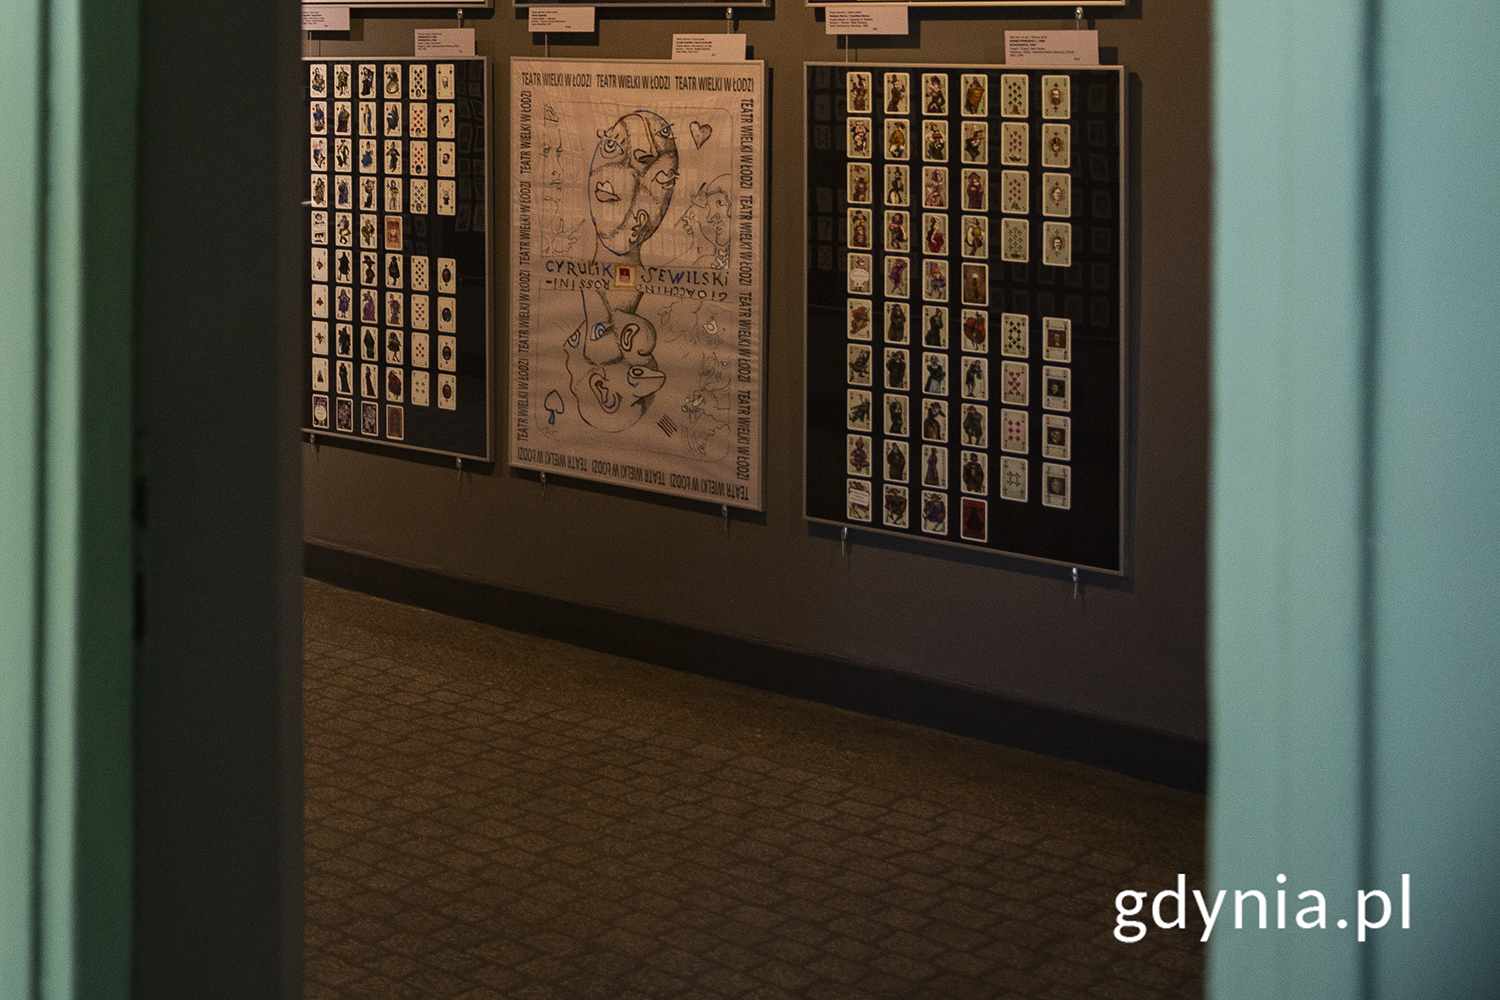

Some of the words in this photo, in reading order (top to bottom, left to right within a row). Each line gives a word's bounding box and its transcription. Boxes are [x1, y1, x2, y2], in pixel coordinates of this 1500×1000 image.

[522, 72, 541, 86] TEATR
[542, 73, 563, 86] WIELKI
[565, 74, 572, 86] W
[572, 73, 592, 88] ŁODZI
[597, 74, 617, 88] TEATR
[618, 75, 640, 89] WIELKI
[642, 75, 650, 89] W
[650, 75, 670, 90] ŁODZI
[675, 76, 696, 90] TEATR
[698, 77, 722, 91] WIELKI
[724, 78, 731, 91] W
[732, 78, 754, 92] ŁODZI
[520, 91, 532, 112] ŁODZI
[741, 99, 753, 123] TEATR
[520, 114, 531, 122] W
[520, 123, 531, 149] WIELKI
[740, 125, 753, 152] WIELKI
[520, 151, 531, 174] TEATR
[740, 155, 752, 163] W
[740, 164, 753, 189] ŁODZI
[519, 181, 531, 203] ŁODZI
[520, 205, 530, 213] W
[739, 195, 753, 220] TEATR
[520, 213, 530, 240] WIELKI
[740, 222, 752, 249] WIELKI
[520, 242, 531, 265] TEATR
[740, 251, 752, 260] W
[518, 270, 530, 292] ŁODZI
[739, 262, 752, 286] ŁODZI
[518, 302, 530, 328] WIELKI
[738, 292, 752, 317] TEATR
[518, 330, 530, 353] TEATR
[738, 319, 752, 346] WIELKI
[738, 349, 751, 357] W
[518, 358, 529, 381] ŁODZI
[738, 358, 752, 382] ŁODZI
[518, 391, 529, 416] WIELKI
[738, 390, 750, 415] TEATR
[517, 418, 529, 442] TEATR
[737, 417, 750, 444] WIELKI
[536, 451, 543, 464] W
[545, 451, 565, 468] WIELKI
[737, 446, 750, 455] W
[567, 455, 587, 471] TEATR
[611, 464, 619, 477] W
[620, 465, 643, 481] WIELKI
[736, 456, 750, 480] ŁODZI
[645, 468, 665, 486] TEATR
[692, 477, 699, 492] W
[701, 478, 725, 497] WIELKI
[726, 483, 749, 500] TEATR
